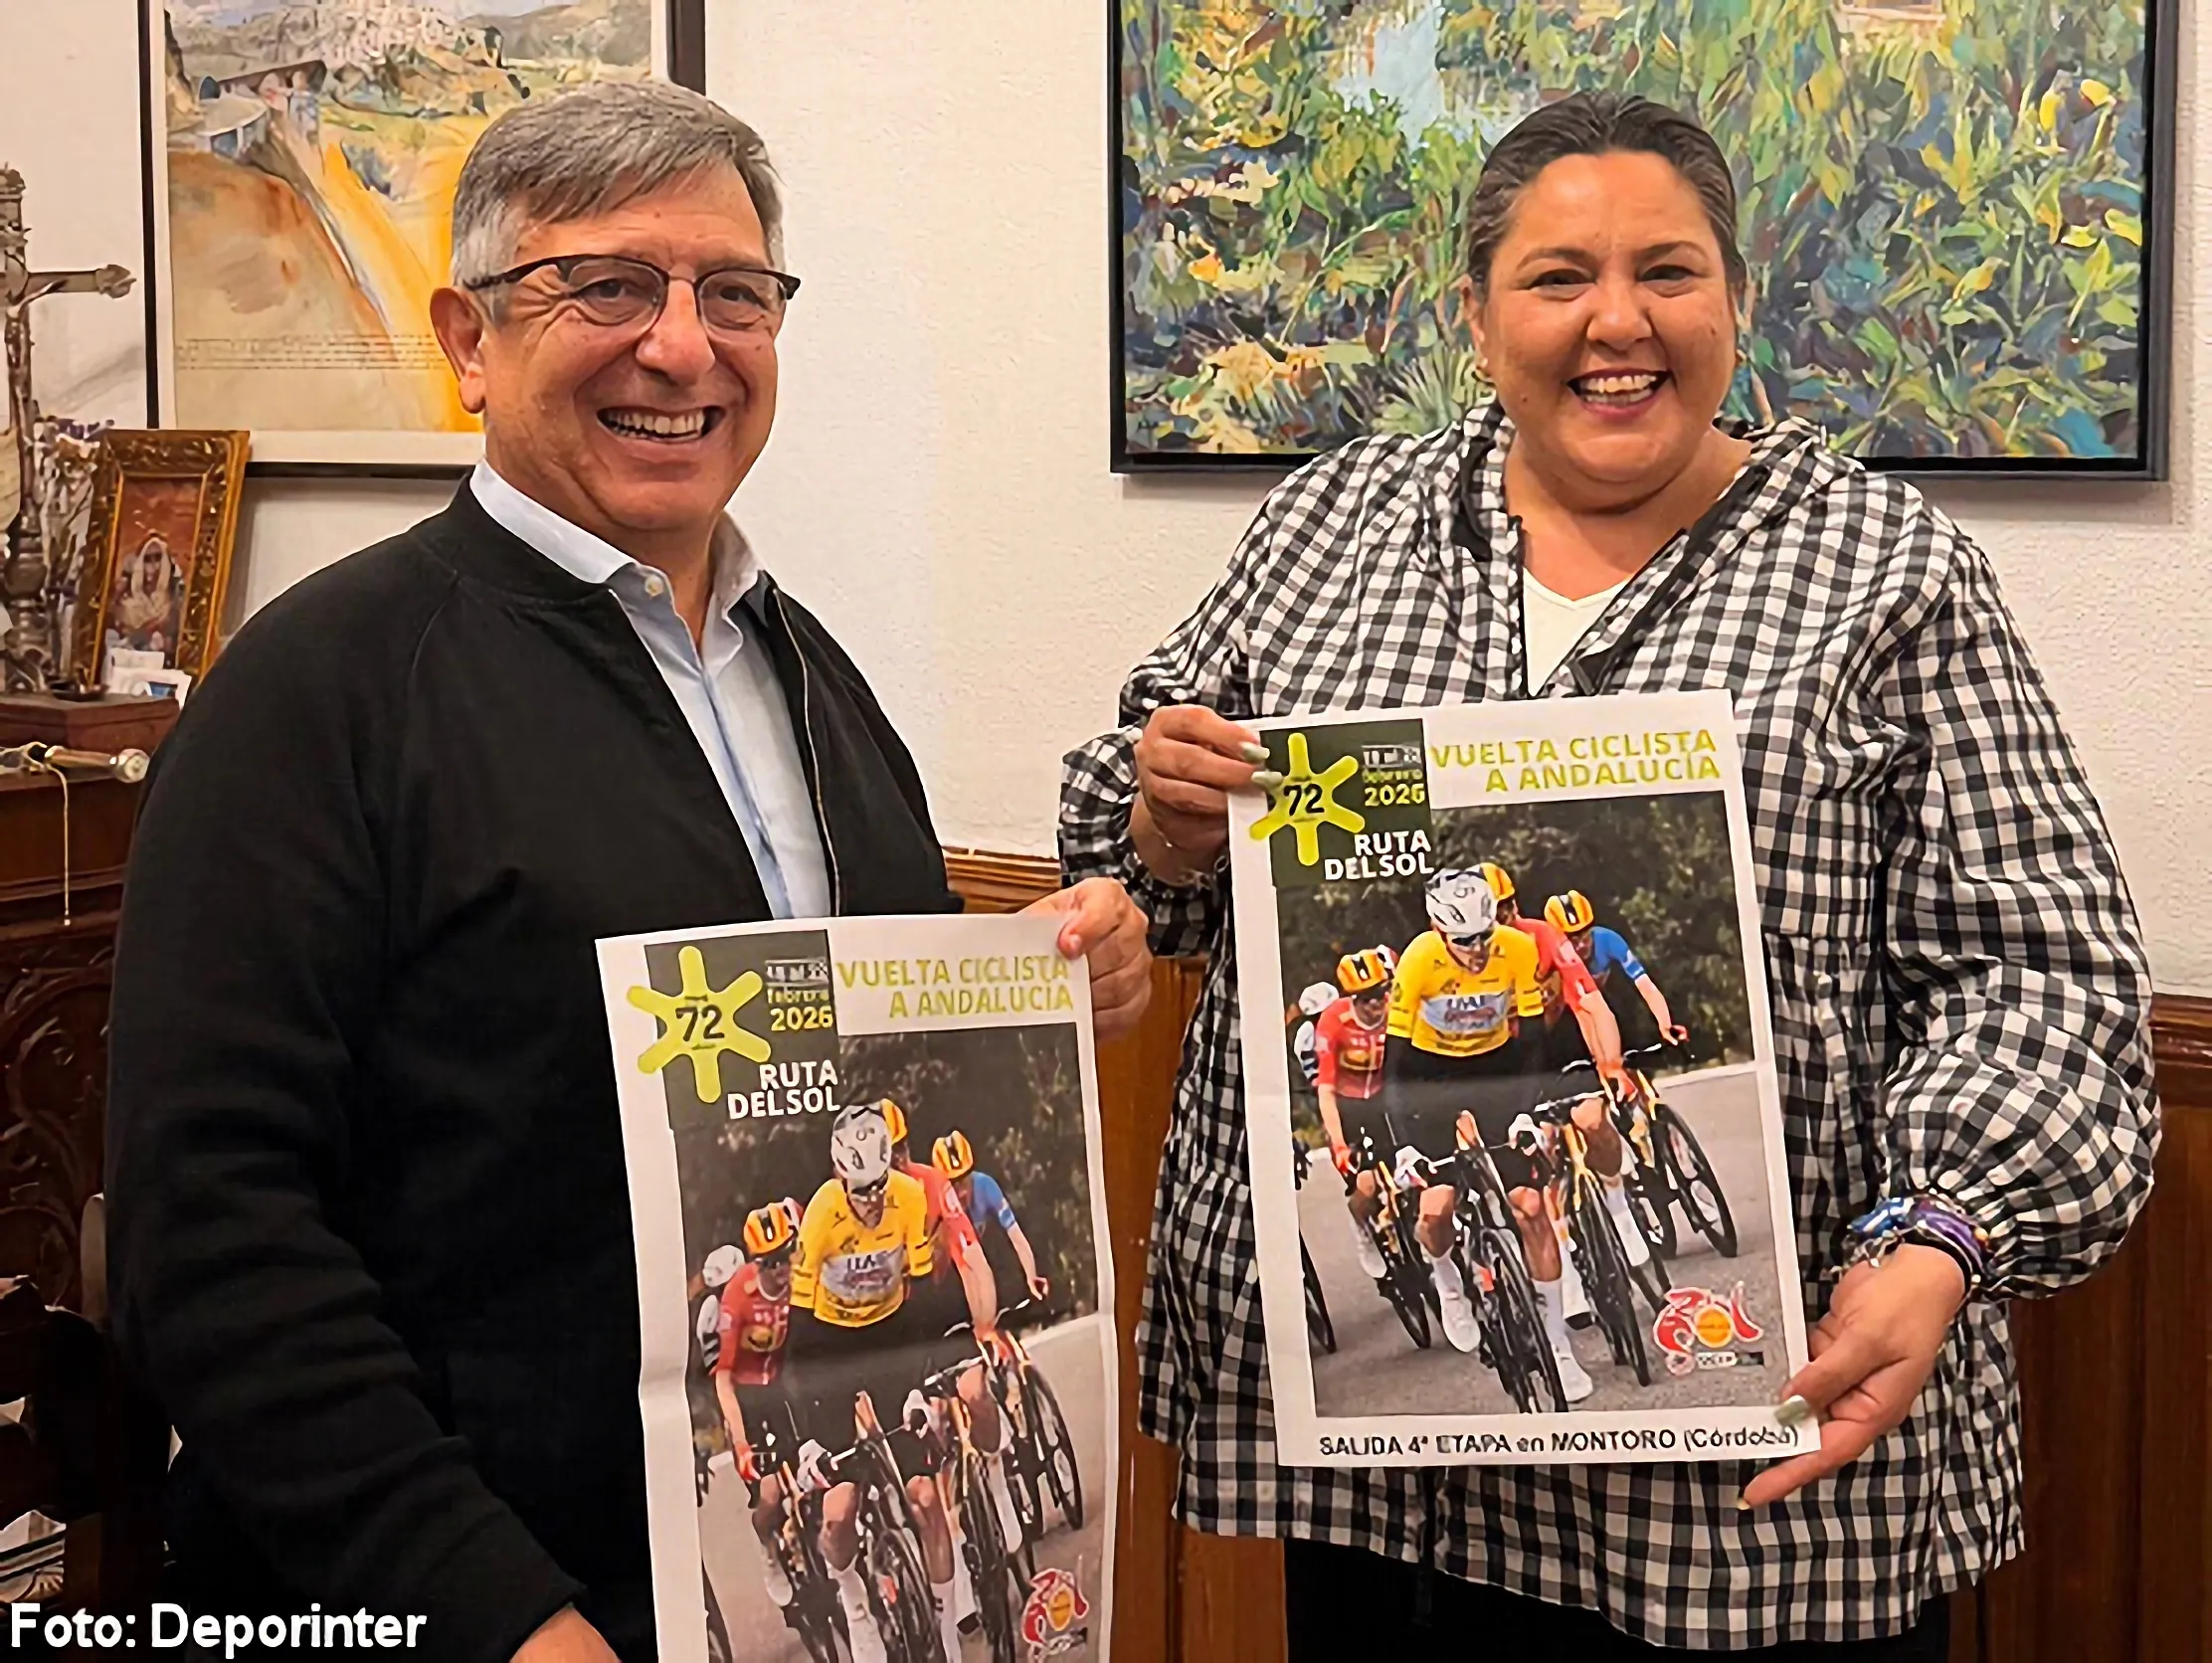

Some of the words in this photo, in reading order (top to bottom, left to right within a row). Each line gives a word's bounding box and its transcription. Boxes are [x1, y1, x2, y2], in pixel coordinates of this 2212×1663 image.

[1431, 739, 1559, 768] VUELTA
[1568, 729, 1717, 760] CICLISTA
[1485, 768, 1508, 793] A
[1283, 783, 1325, 817] 72
[1354, 830, 1432, 856] RUTA
[836, 959, 952, 989] VUELTA
[959, 954, 1069, 984] CICLISTA
[770, 1005, 833, 1031] 2026
[889, 991, 909, 1018] A
[675, 1004, 725, 1042] 72
[759, 1059, 838, 1091] RUTA
[1319, 1435, 1403, 1456] SALIDA
[1435, 1433, 1512, 1454] ETAPA
[1551, 1428, 1676, 1452] MONTORO
